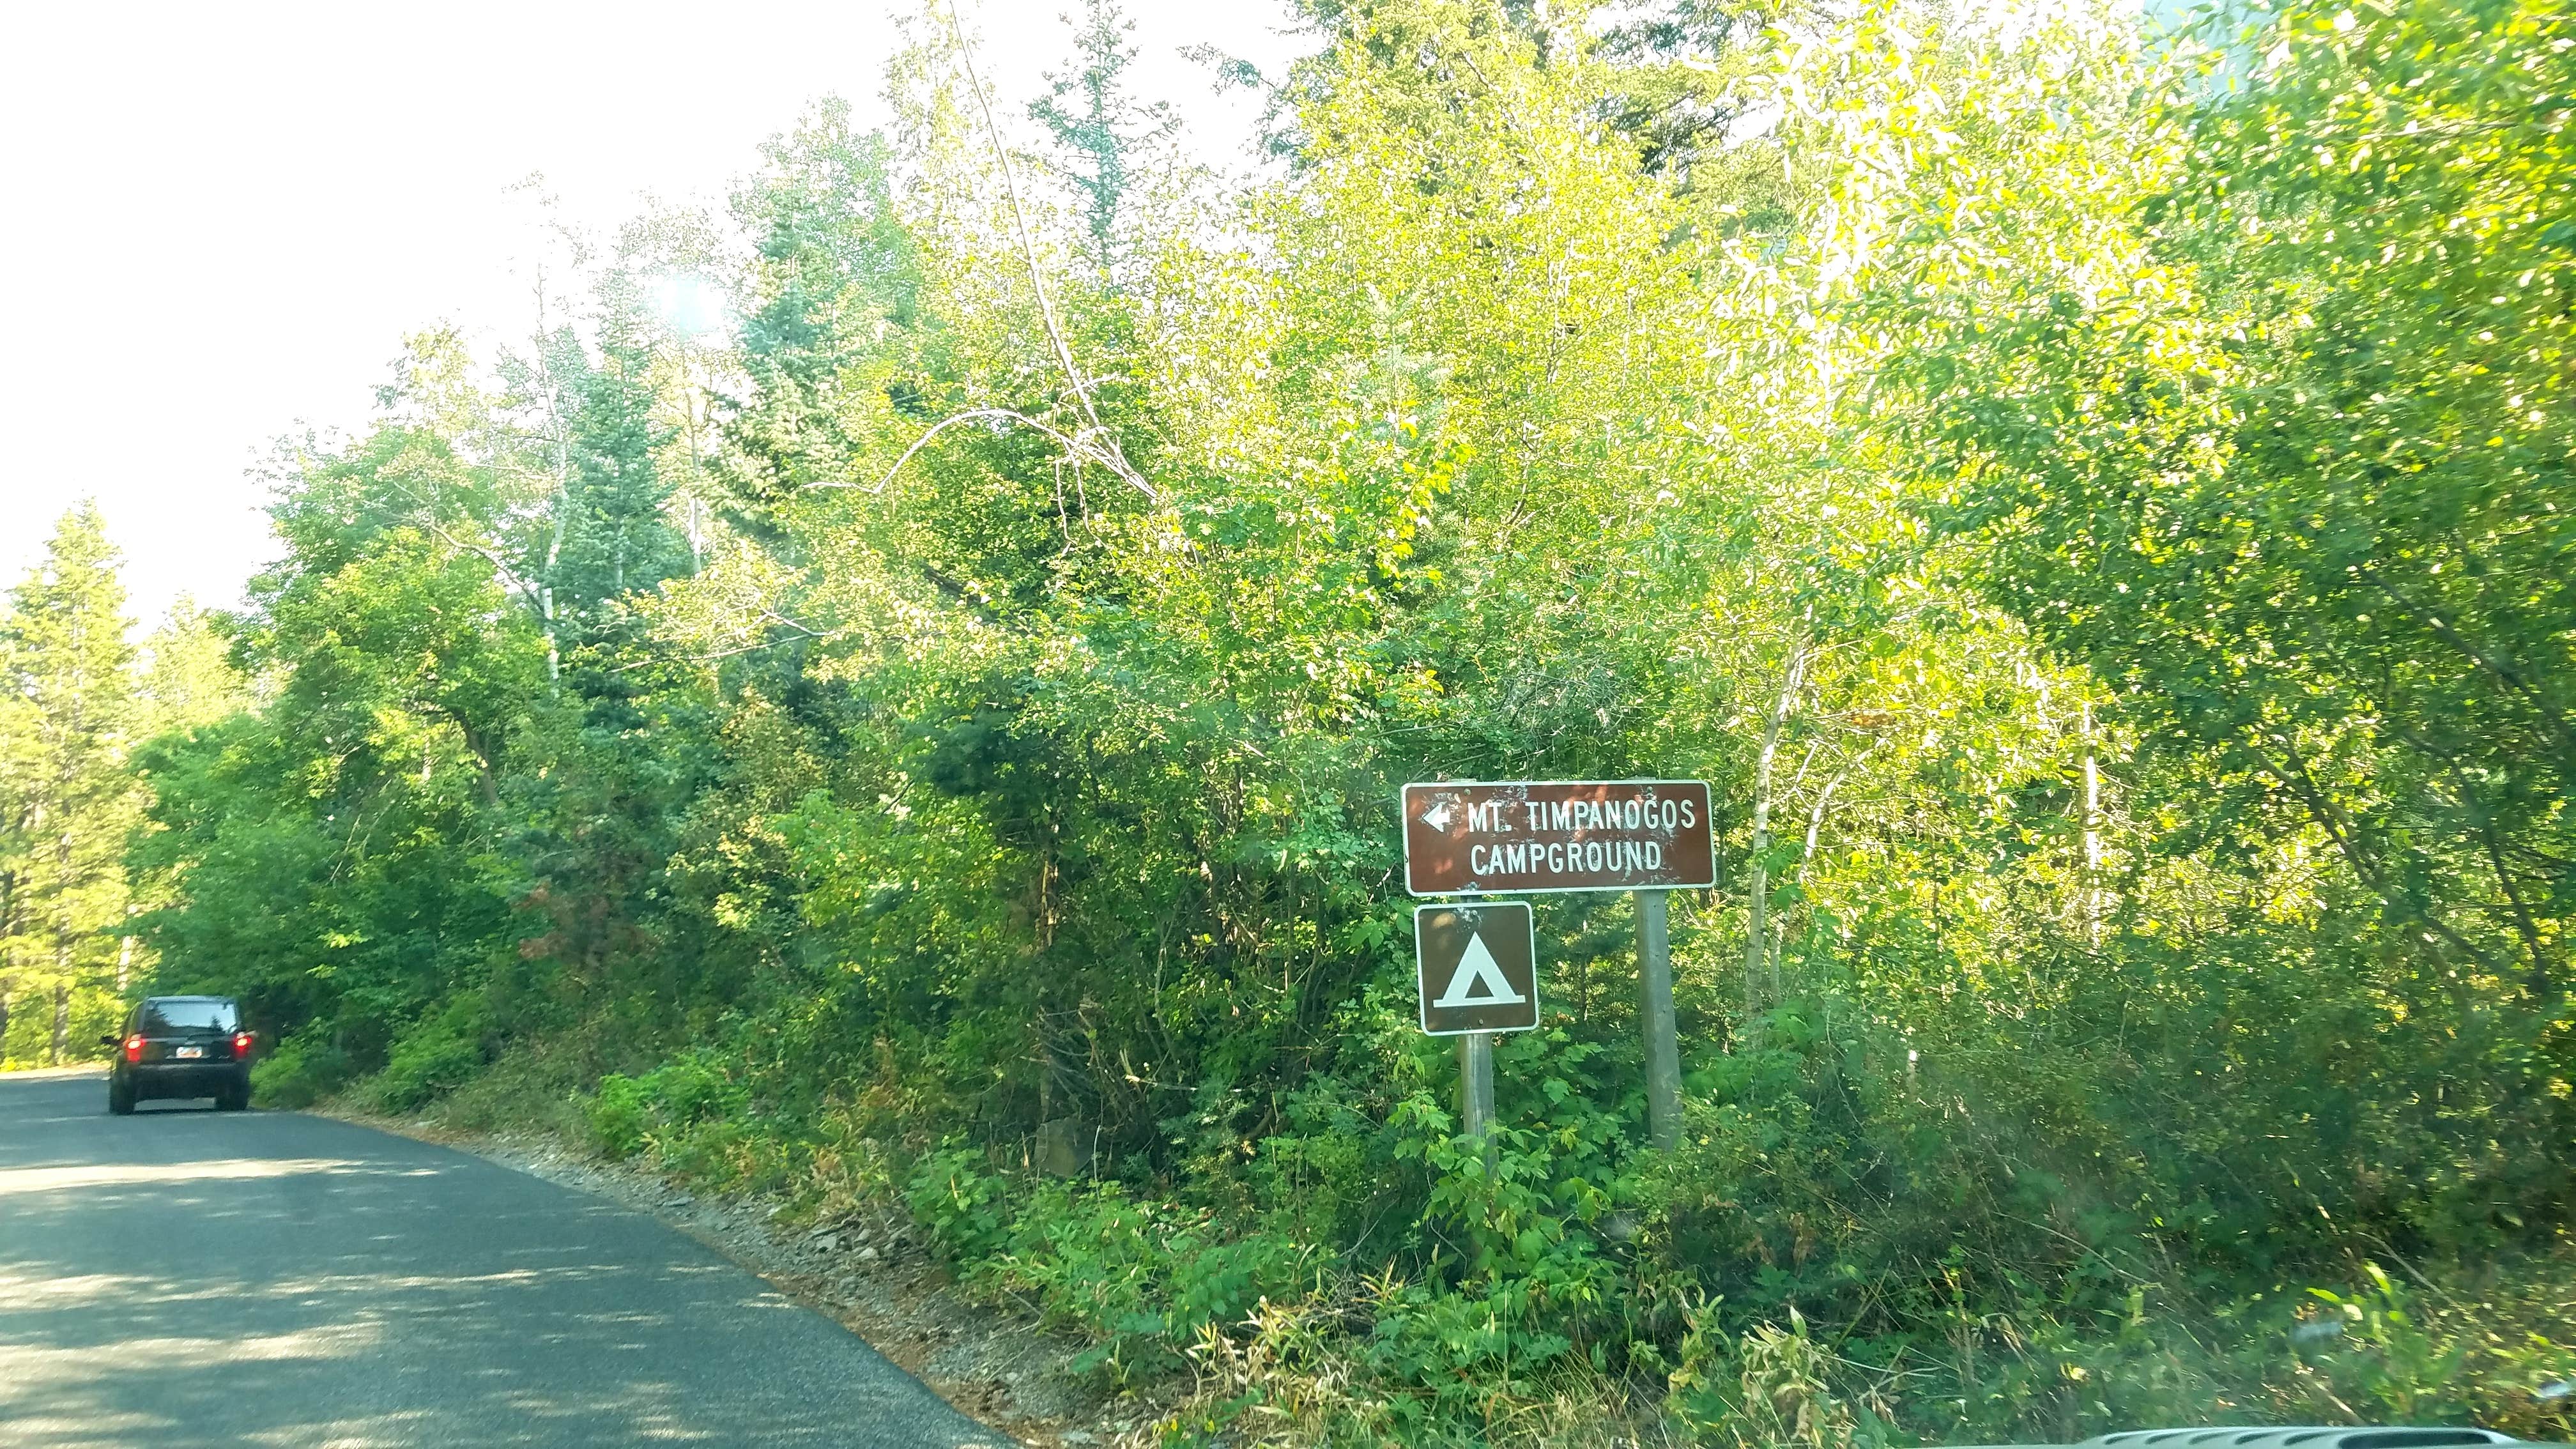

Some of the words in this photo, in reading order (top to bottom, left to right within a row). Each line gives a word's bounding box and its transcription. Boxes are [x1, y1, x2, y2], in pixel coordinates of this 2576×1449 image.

[1468, 802, 1512, 832] MT.
[1525, 799, 1696, 831] TIMPANOGOS
[1471, 841, 1662, 875] CAMPGROUND
